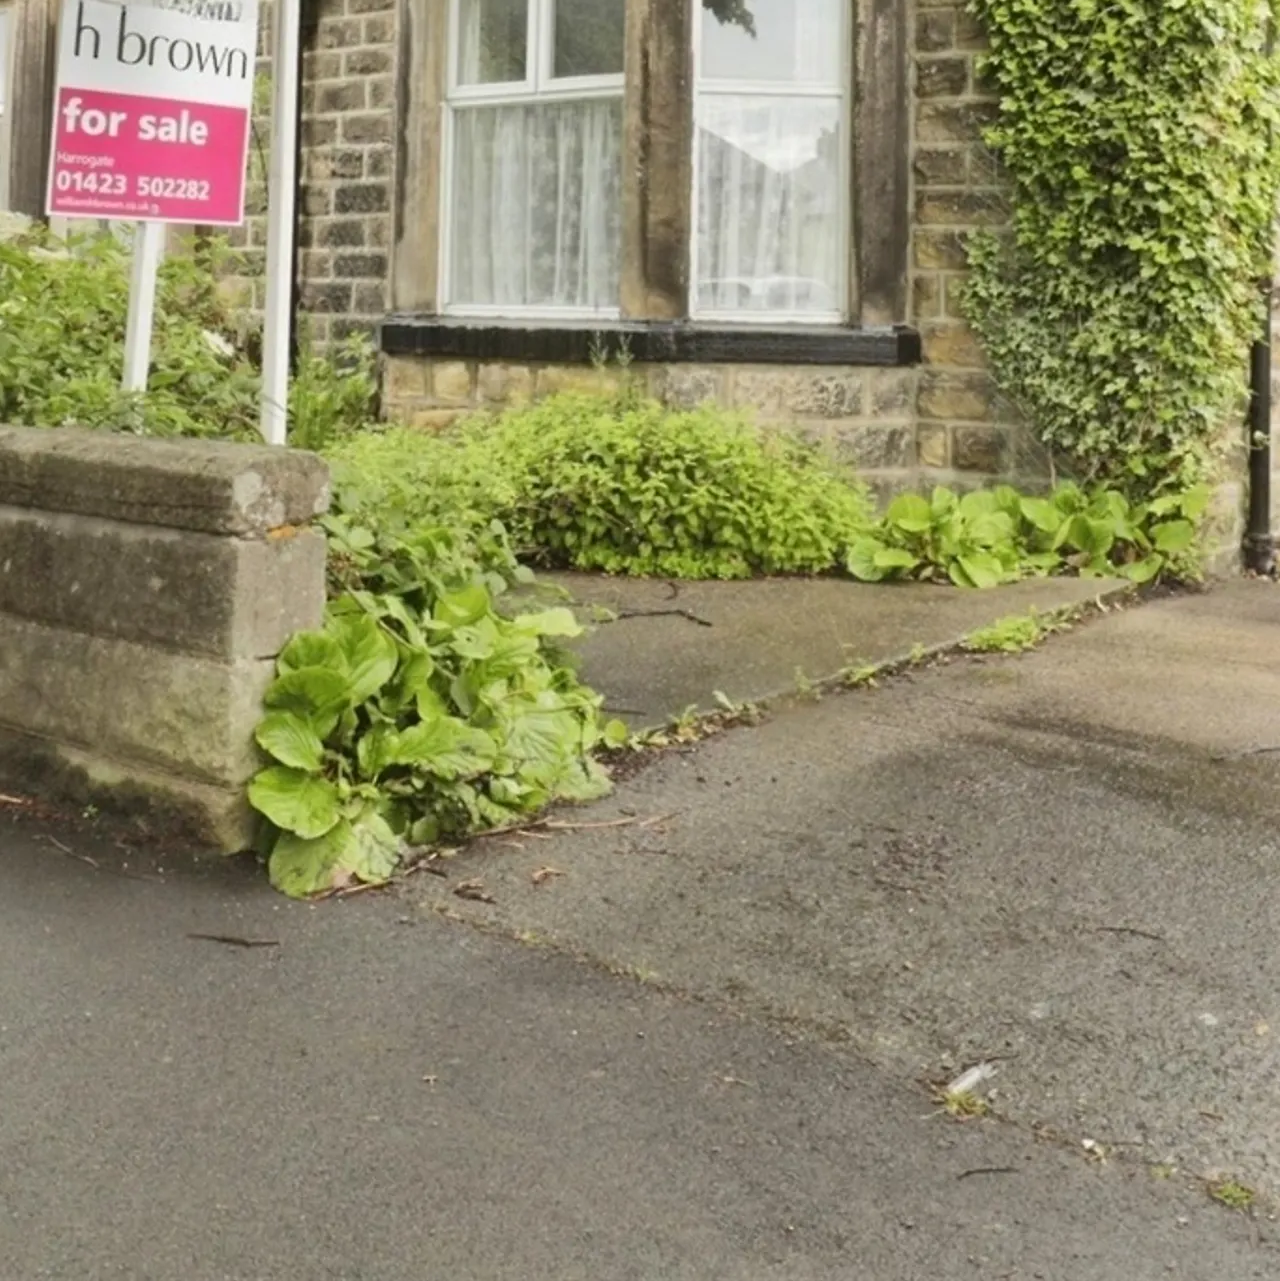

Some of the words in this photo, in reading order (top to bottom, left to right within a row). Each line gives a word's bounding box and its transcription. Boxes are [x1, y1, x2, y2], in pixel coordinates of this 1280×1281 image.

[74, 0, 101, 60] h
[117, 5, 248, 79] brown
[62, 97, 128, 137] for
[137, 109, 209, 146] sale
[56, 151, 115, 169] Harrogate
[56, 170, 127, 194] 01423
[136, 176, 210, 201] 502282
